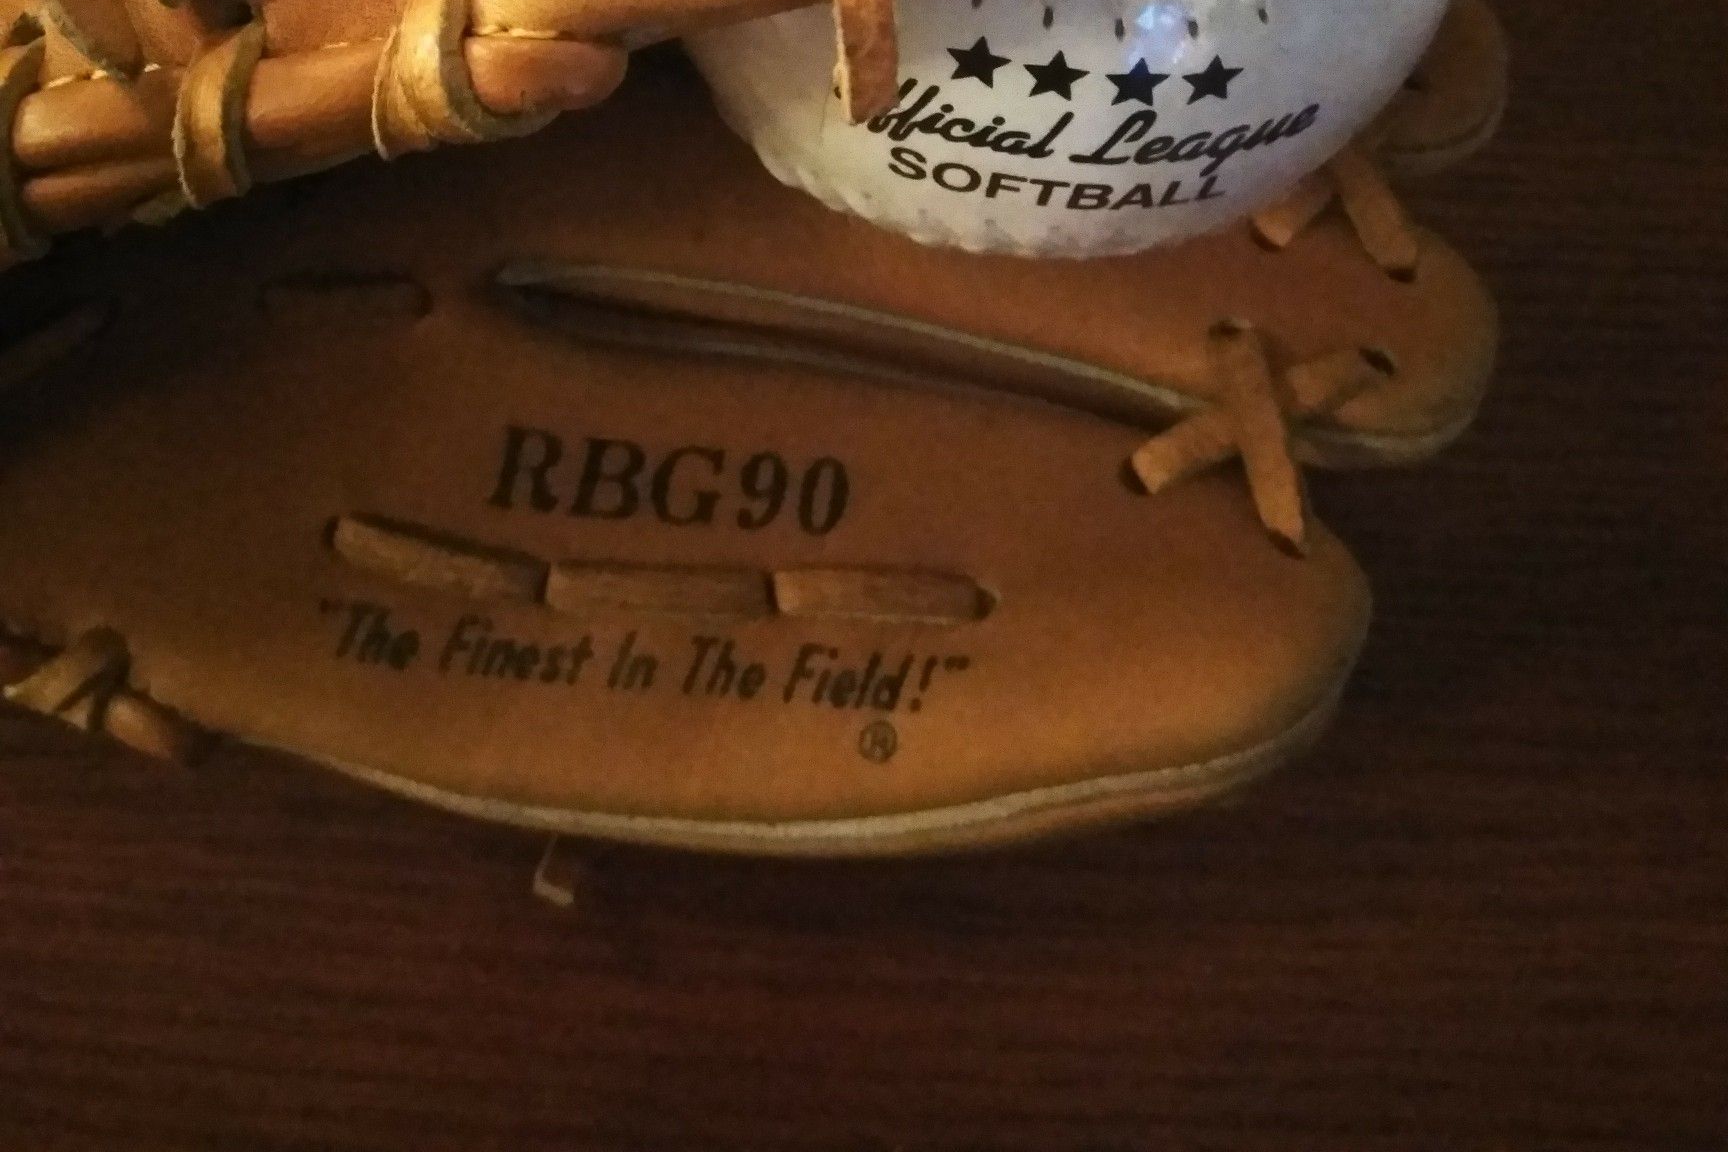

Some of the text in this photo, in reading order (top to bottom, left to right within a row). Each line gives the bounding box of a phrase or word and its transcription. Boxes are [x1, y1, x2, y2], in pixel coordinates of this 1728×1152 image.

[834, 77, 1320, 177] fficial League
[887, 146, 1226, 211] SOFTBALL
[487, 423, 851, 537] RBG90
[438, 613, 594, 686] Finest
[606, 629, 659, 690] In
[682, 634, 767, 699] The
